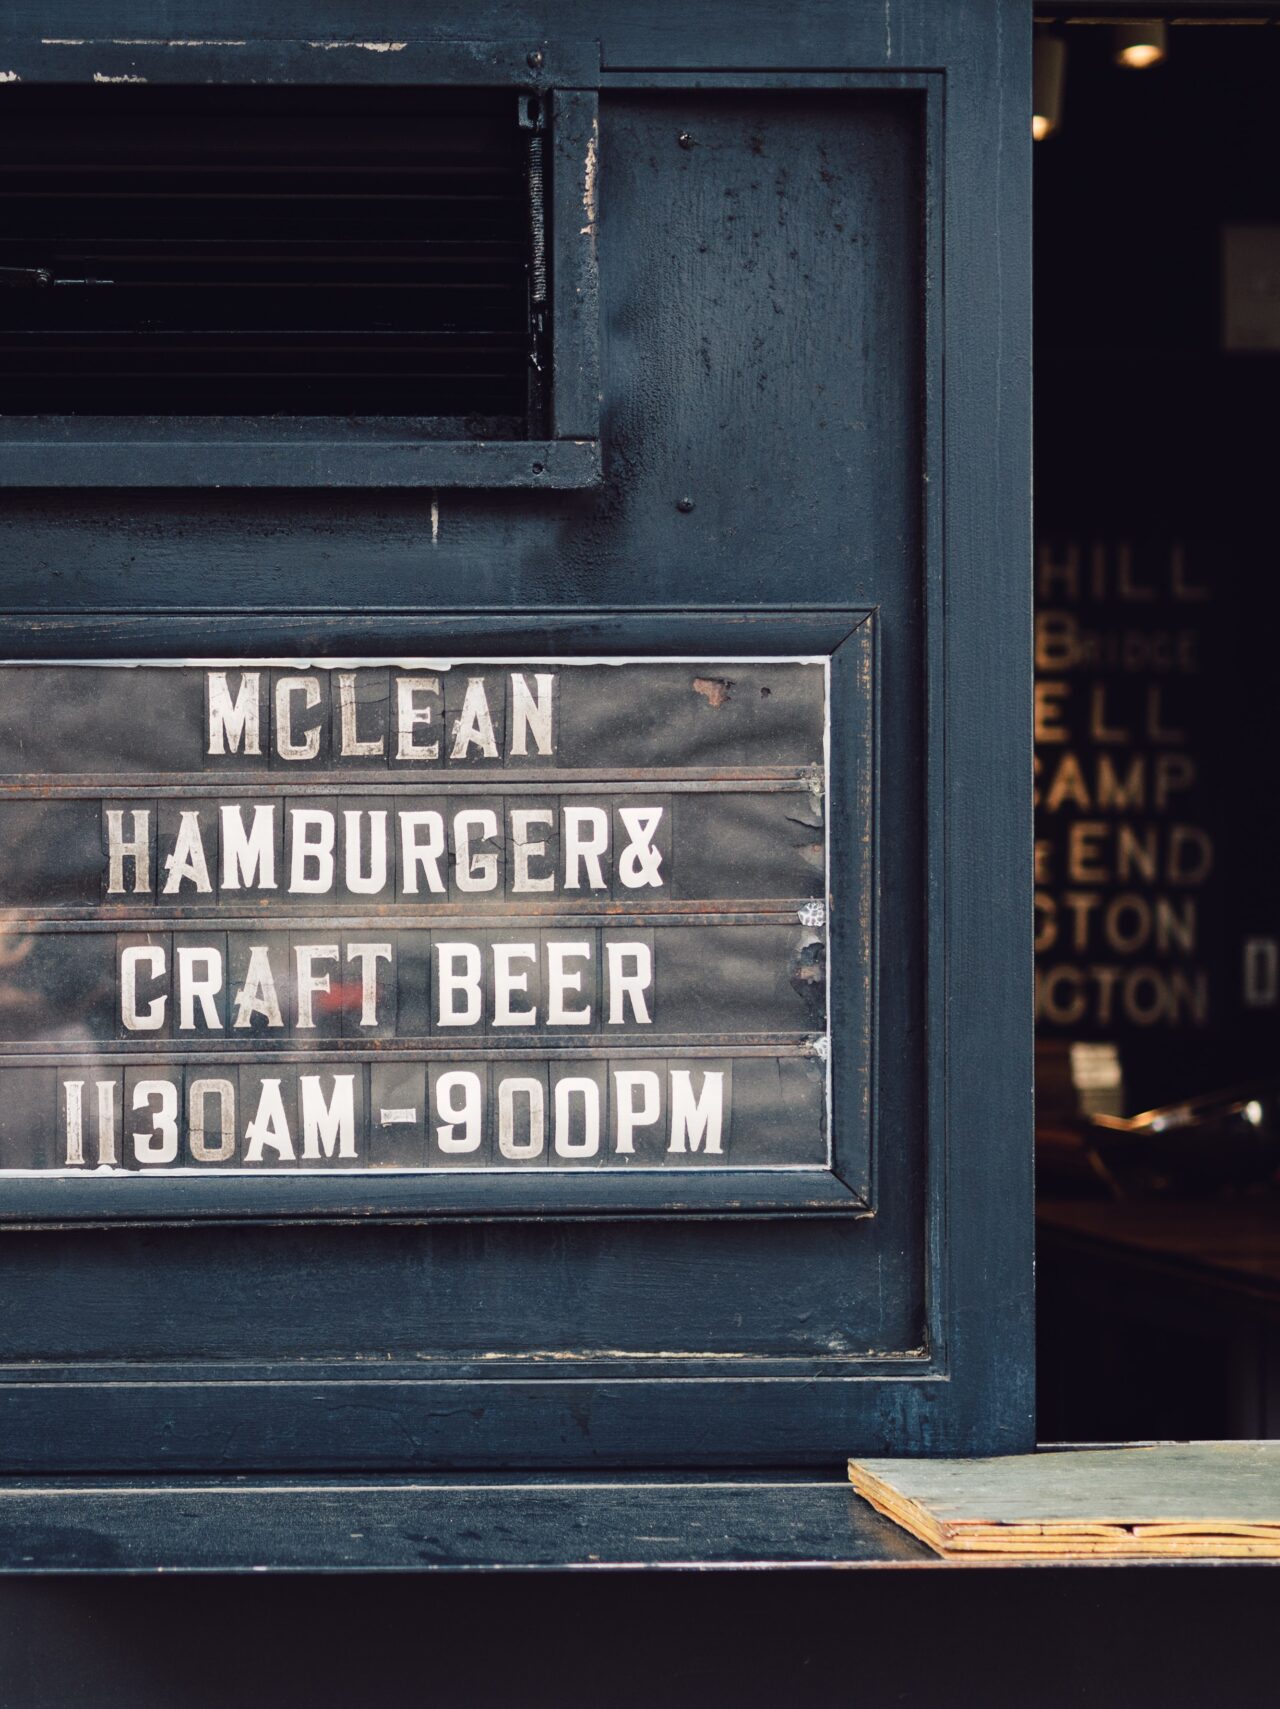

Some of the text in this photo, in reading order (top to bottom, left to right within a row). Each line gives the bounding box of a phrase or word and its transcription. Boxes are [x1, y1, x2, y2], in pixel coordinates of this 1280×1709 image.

[1038, 542, 1211, 603] HILL
[207, 671, 555, 760] MCLEAN
[1034, 752, 1195, 814] AMP
[105, 804, 664, 894] HAMBURGER&
[1067, 819, 1213, 885] END
[120, 942, 652, 1030] CRAFT BEER
